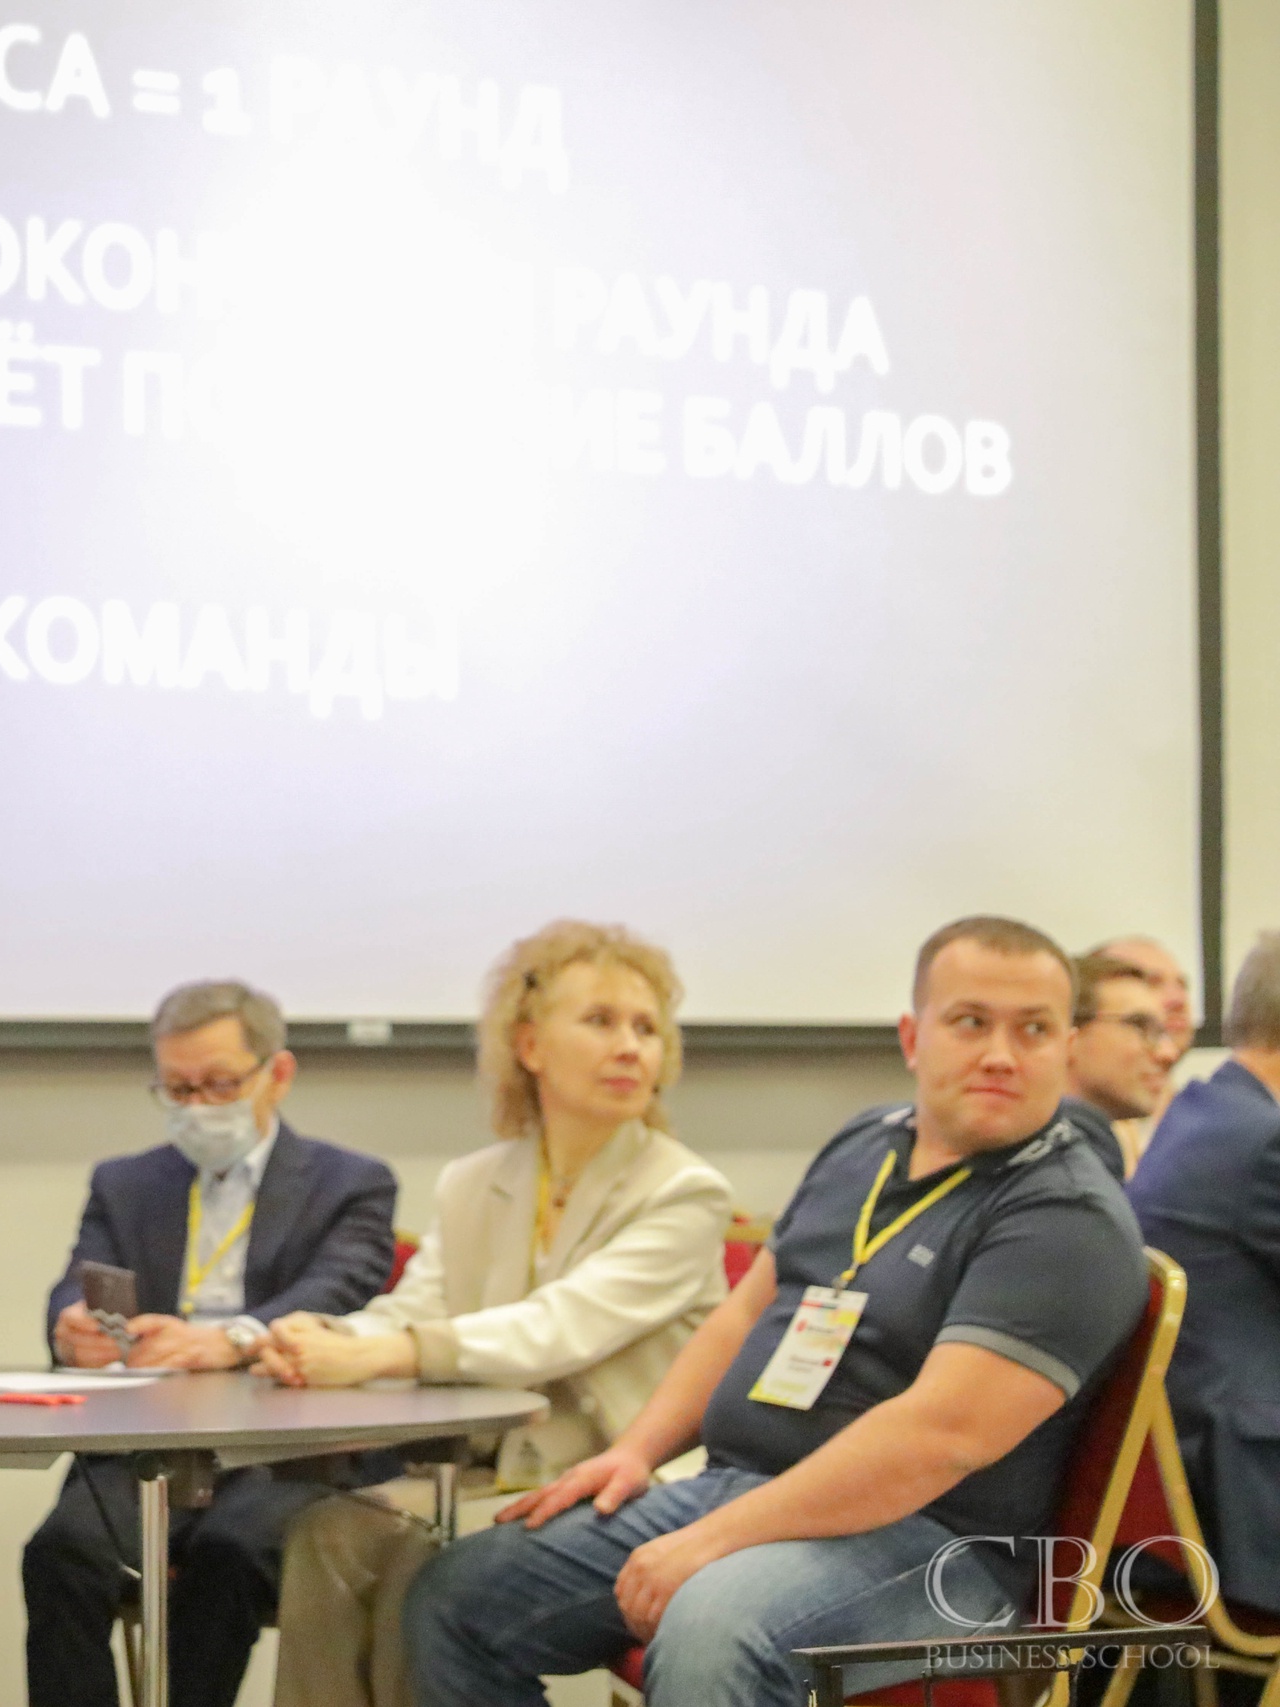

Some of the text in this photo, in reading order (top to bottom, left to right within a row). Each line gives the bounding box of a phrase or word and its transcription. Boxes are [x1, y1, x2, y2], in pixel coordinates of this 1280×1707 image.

[201, 66, 252, 136] 1
[268, 54, 570, 195] РАУНД
[552, 266, 891, 394] РАУНДА
[681, 394, 1013, 497] БАЛЛОВ
